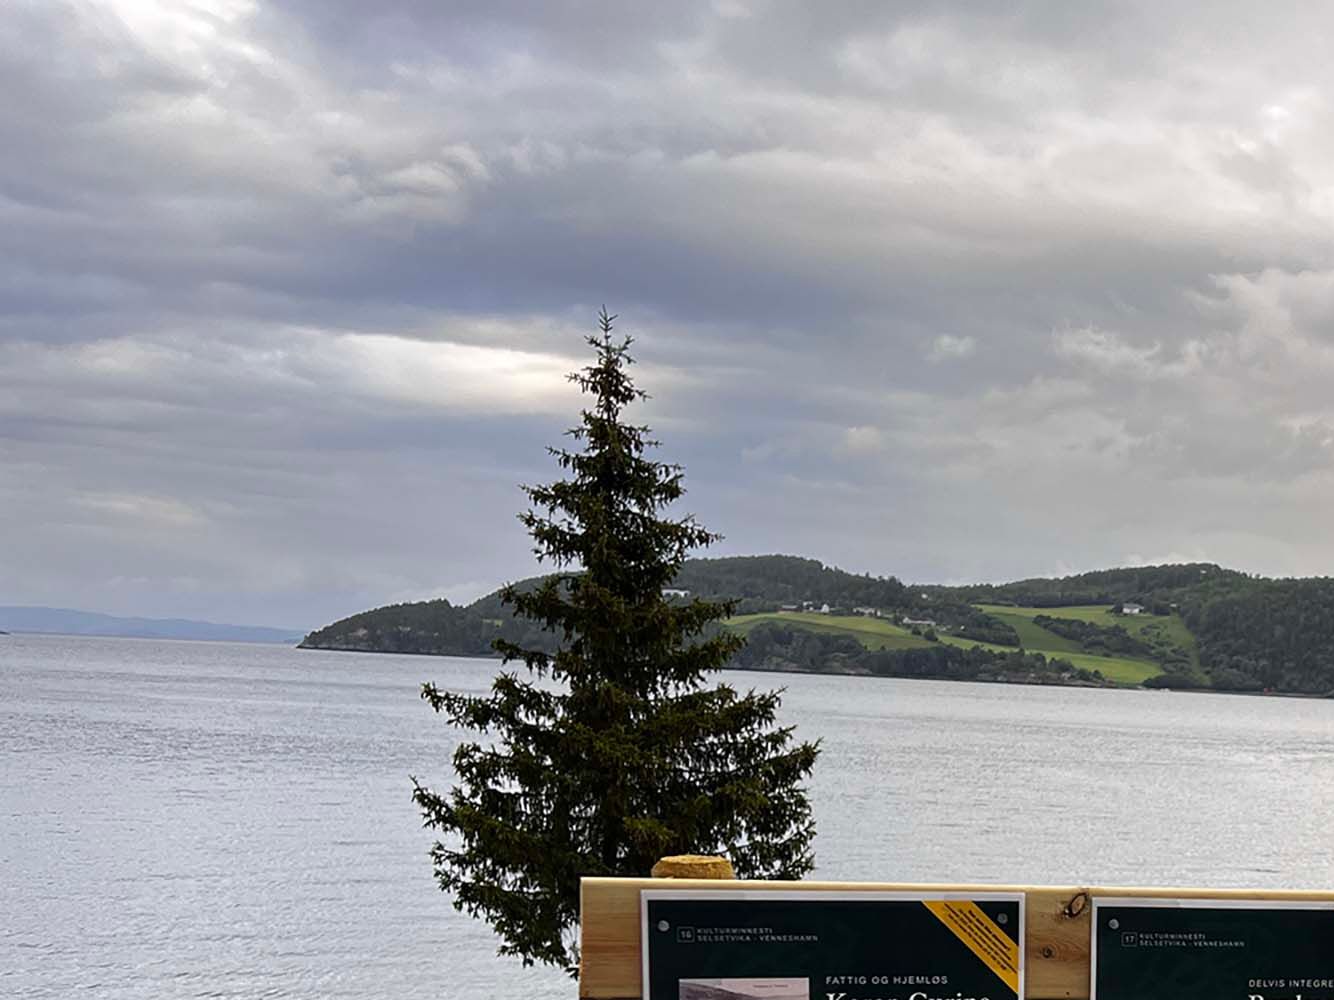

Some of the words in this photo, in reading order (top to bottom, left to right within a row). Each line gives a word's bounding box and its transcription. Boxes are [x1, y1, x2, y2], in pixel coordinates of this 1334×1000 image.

[681, 930, 692, 939] 16
[1125, 935, 1135, 943] 17
[826, 976, 867, 985] FATTIG
[871, 976, 889, 985] OG
[893, 975, 948, 985] HJEMLØS
[1248, 979, 1286, 988] DELVIS
